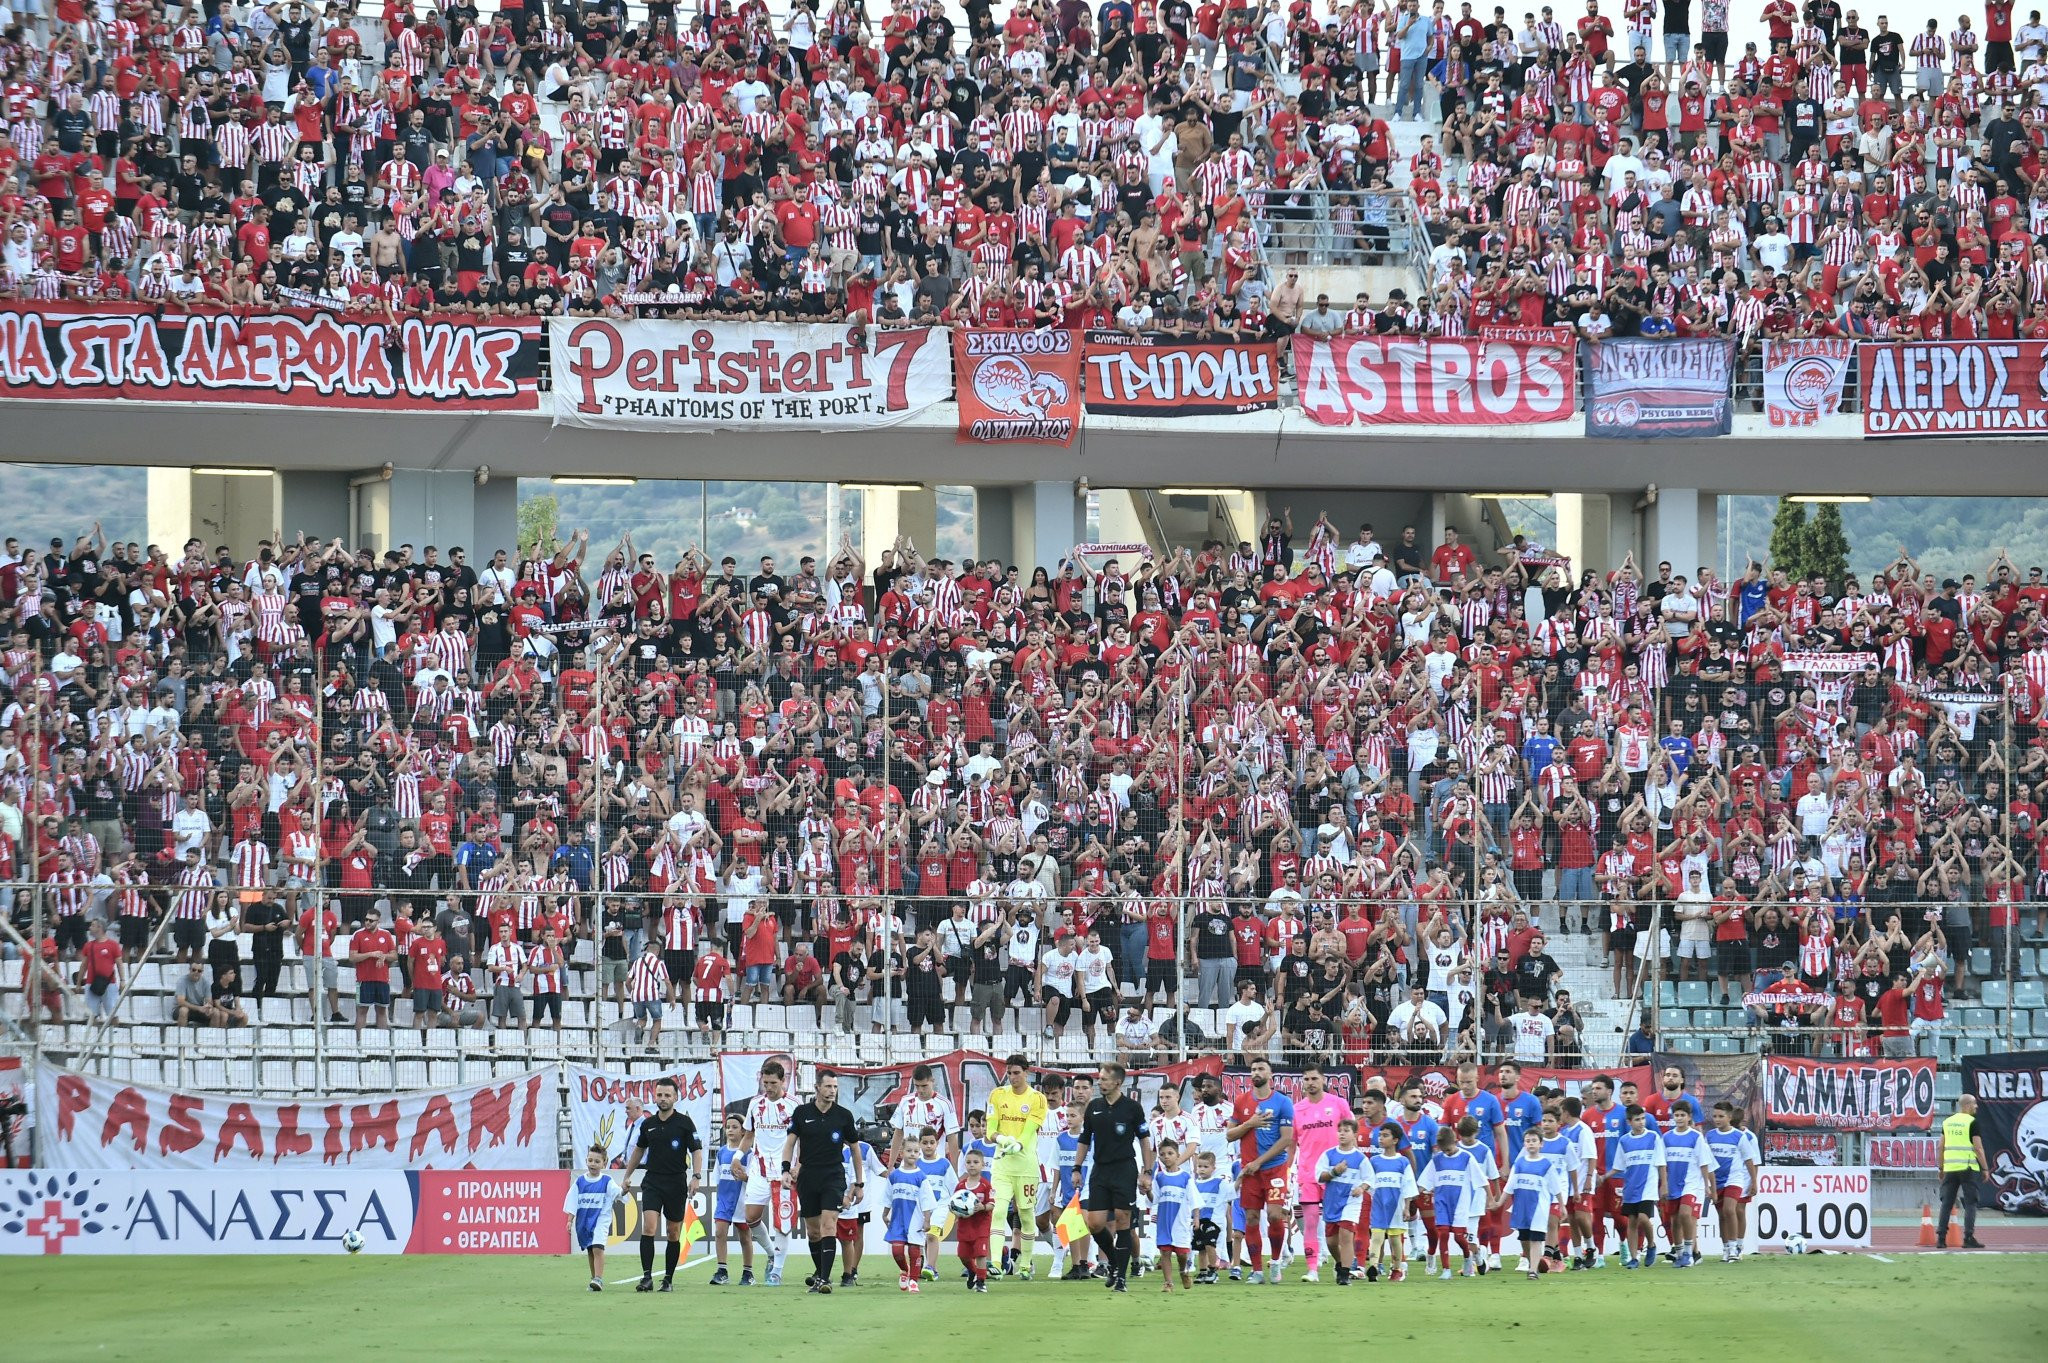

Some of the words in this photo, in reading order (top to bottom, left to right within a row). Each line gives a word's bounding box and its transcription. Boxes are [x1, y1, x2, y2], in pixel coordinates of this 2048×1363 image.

[967, 330, 1070, 356] ΣΚΙΑΘΟΣ
[1561, 329, 1570, 344] 7
[0, 317, 52, 380] ΙΑ
[65, 320, 165, 382] ΣΤΑ
[181, 316, 396, 393] ΑΔΕΡΦΙΑ
[405, 322, 520, 396] ΜΑΣ
[1600, 341, 1728, 381] ΛΕΥΚΩΣΙΑ
[1765, 339, 1849, 373] ΑΡΙΔΑΙΑ
[568, 321, 872, 414] Peristeri
[875, 328, 931, 411] 7
[1087, 347, 1273, 401] ΤΡΙΠΟΛΗ
[1303, 341, 1565, 414] ASTROS
[1869, 345, 2020, 410] ΛΕΡΟΣ
[740, 401, 765, 419] OF
[773, 399, 813, 418] THE
[1641, 409, 1682, 418] PSYCHO
[1686, 408, 1713, 416] REDS
[1824, 393, 1839, 415] 7
[971, 418, 1071, 441] ΟΛΥΜΠΙΑΚΟΣ
[1090, 543, 1141, 552] ΟΛΥΜΠΙΑΚΟΣ
[1803, 660, 1860, 670] ΓΑΛΑΤΣΙ
[1928, 692, 1998, 703] ΚΑΡΠΕΝΗΣΙ
[702, 960, 714, 979] 7
[579, 1071, 708, 1104] IOANNNA
[1772, 1064, 1935, 1118] ΚΑΜΑΤΕΡΟ
[1977, 1071, 2036, 1098] ΝΕΑ
[55, 1074, 543, 1167] PASALIMANI
[1302, 1120, 1333, 1131] novibet
[1815, 1116, 1892, 1128] ΟΛΥΜΠΙΑΚΟΣ
[1870, 1139, 1940, 1168] ΛΕΩΝΙΔ
[457, 1181, 543, 1200] ΠΡΟΛΗΨΗ
[1023, 1184, 1036, 1198] 86
[1268, 1188, 1281, 1201] 22
[1813, 1174, 1868, 1194] STAND
[457, 1206, 541, 1225] ΔΙΑΓΝΩΣΗ
[1758, 1202, 1868, 1241] 0.100
[457, 1232, 540, 1250] ΘΕΡΑΠΕΙΑ
